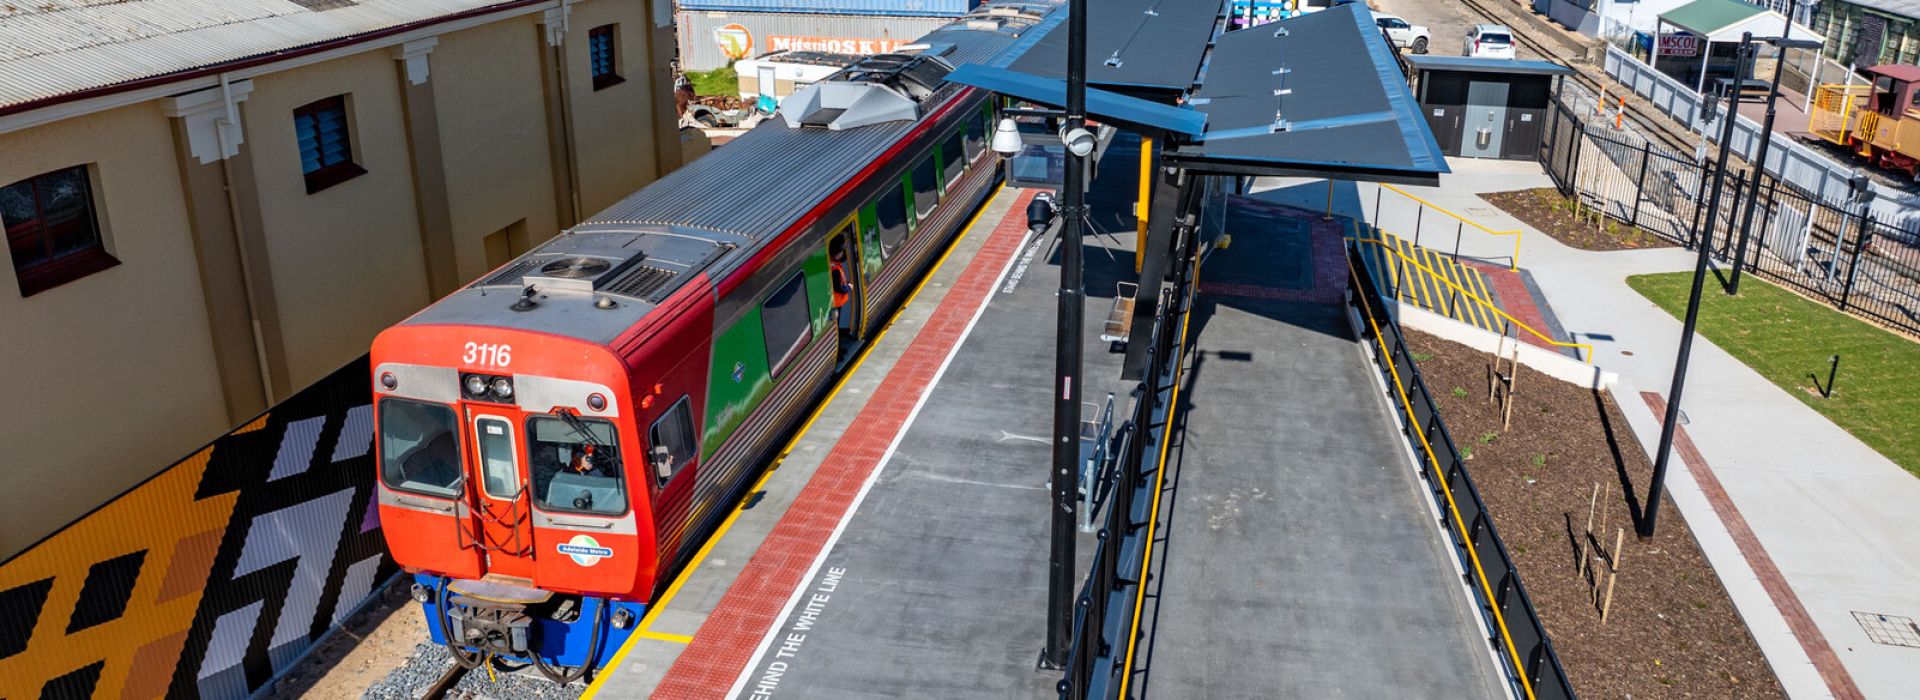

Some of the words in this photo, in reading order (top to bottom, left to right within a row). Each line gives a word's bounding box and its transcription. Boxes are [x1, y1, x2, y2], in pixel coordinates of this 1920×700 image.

[1659, 36, 1697, 49] MSCOL
[463, 341, 512, 368] 3116
[776, 633, 806, 658] THE
[793, 593, 830, 630] WHITE
[818, 567, 846, 592] LINE
